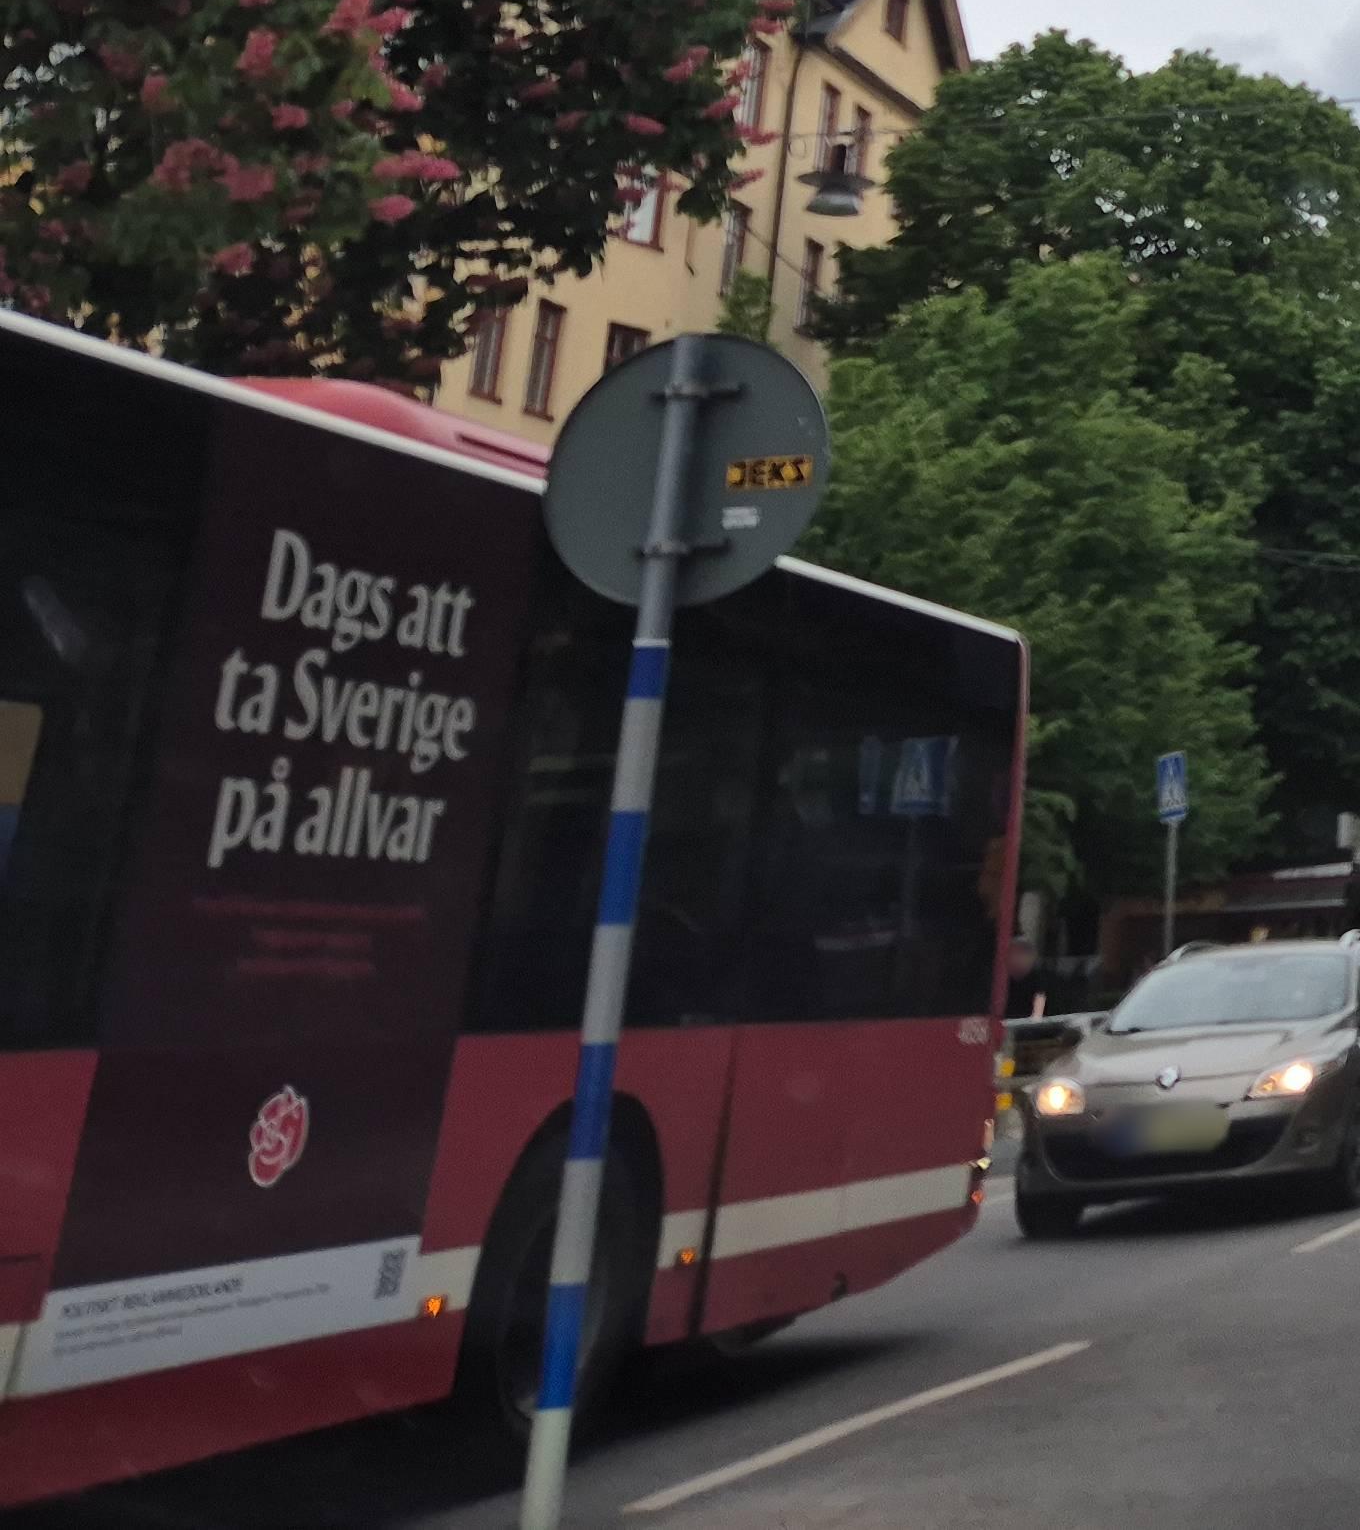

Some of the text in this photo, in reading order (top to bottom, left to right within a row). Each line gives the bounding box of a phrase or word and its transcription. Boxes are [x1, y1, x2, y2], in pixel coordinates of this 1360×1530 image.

[261, 528, 475, 657] Dags att
[215, 647, 476, 773] ta Sverige
[207, 756, 447, 868] på allvar
